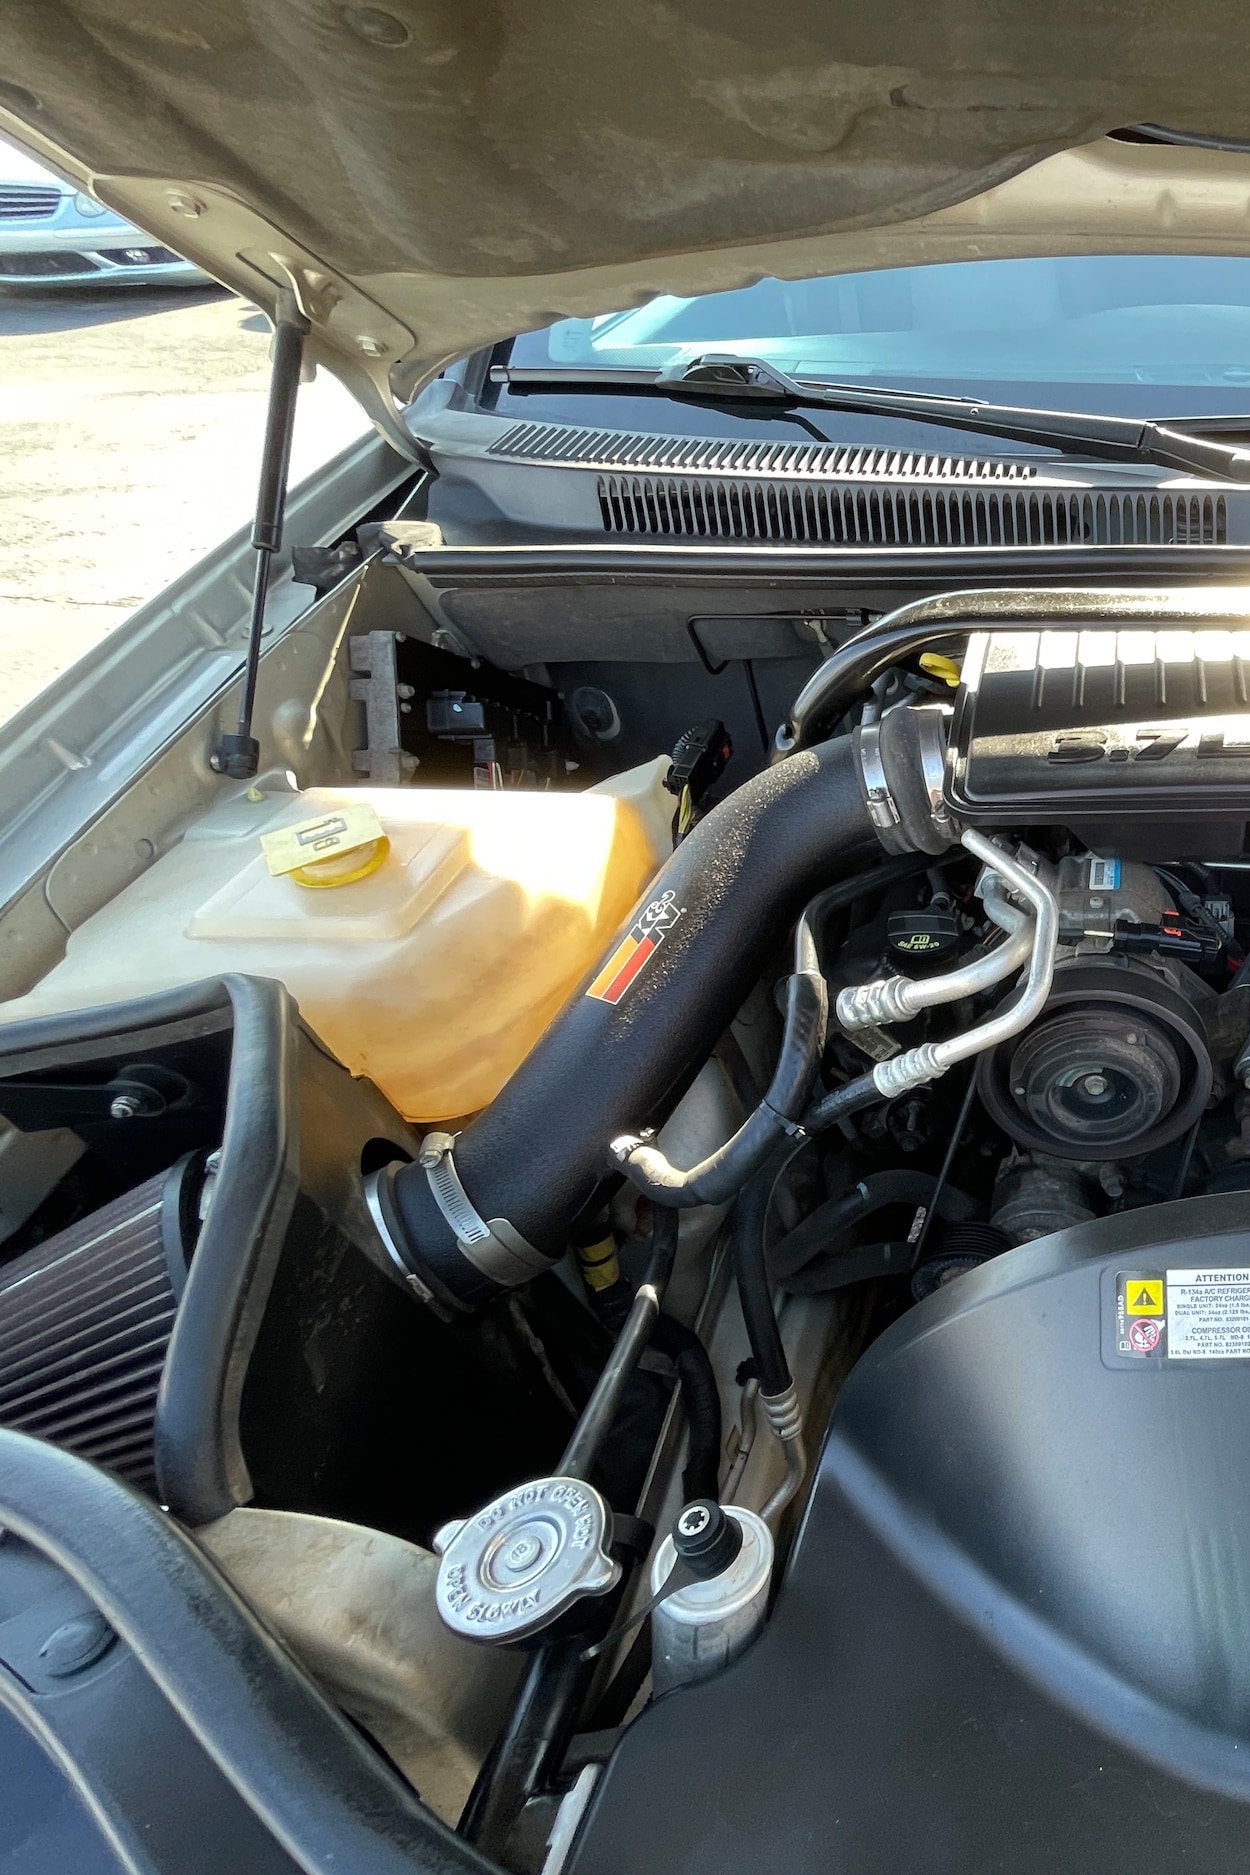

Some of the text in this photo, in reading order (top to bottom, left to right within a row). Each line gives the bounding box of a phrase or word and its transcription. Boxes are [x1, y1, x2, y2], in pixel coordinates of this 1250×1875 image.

[630, 890, 681, 945] K&N
[897, 940, 914, 950] SAE
[1195, 1273, 1250, 1283] ATTENTION
[1180, 1288, 1203, 1296] R-134a
[1191, 1327, 1241, 1335] COMPRESSOR
[478, 1484, 595, 1551] DO NOT OPEN HOT
[446, 1562, 542, 1623] OPEN SLOWLY
